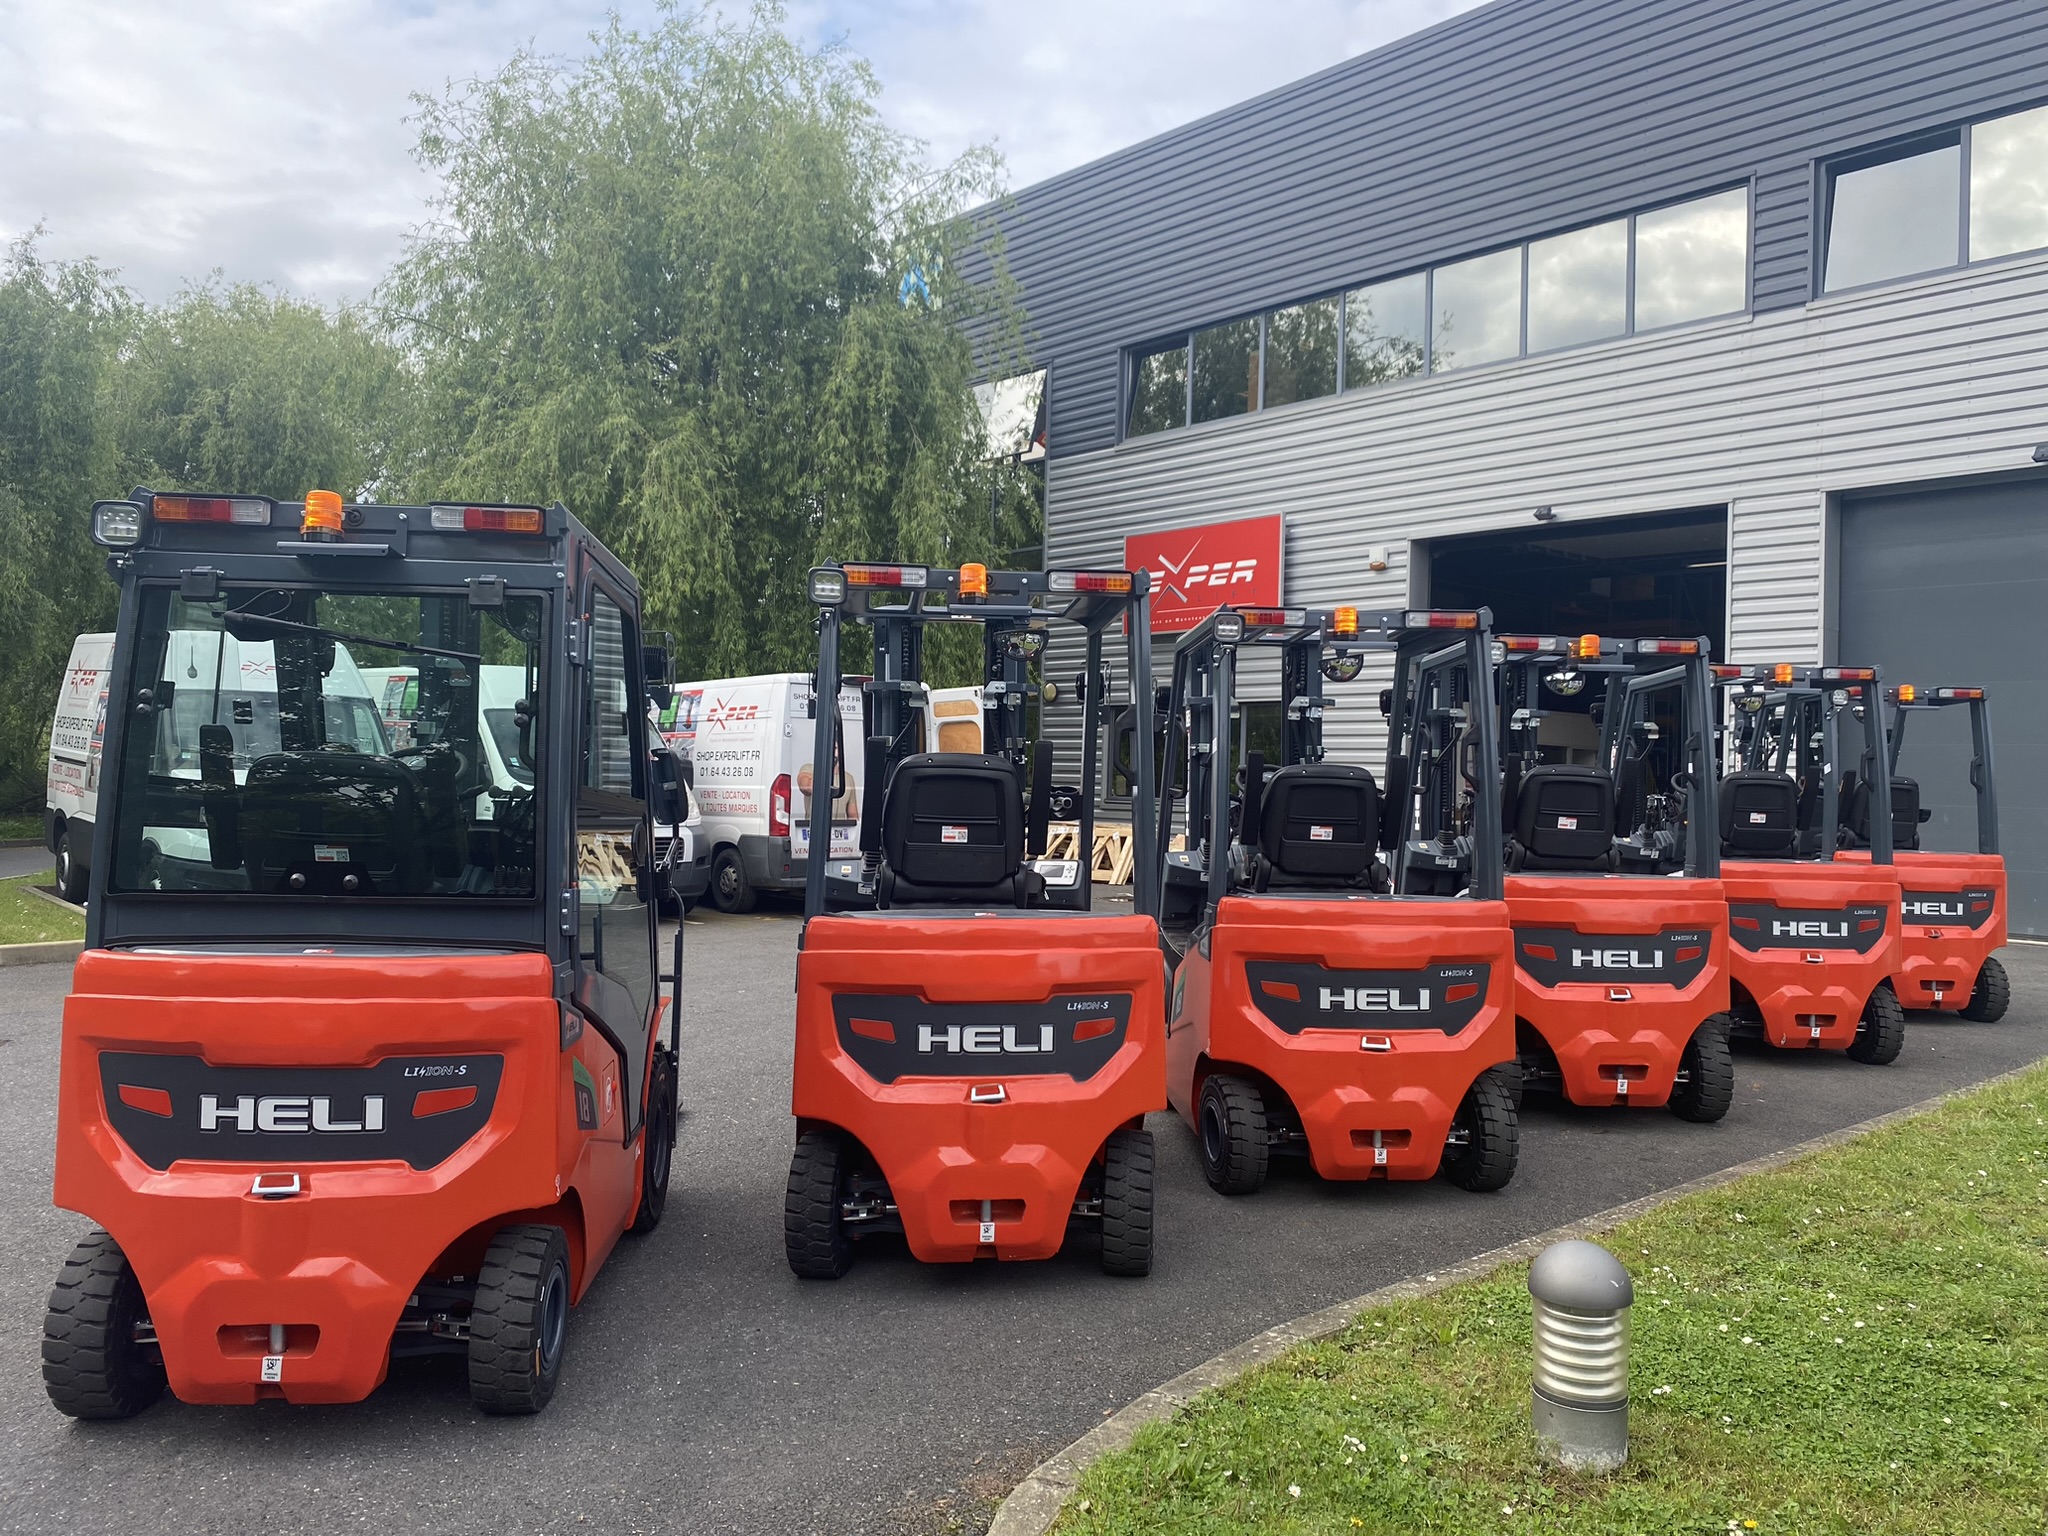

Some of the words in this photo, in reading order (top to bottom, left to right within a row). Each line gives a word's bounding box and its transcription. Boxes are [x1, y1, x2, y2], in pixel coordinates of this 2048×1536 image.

[1149, 540, 1257, 606] EXPER
[696, 750, 760, 762] SHOP.EXPERLIFT.FR
[699, 766, 754, 777] 01.64.43.26.08
[700, 790, 717, 799] VENTE
[722, 791, 751, 800] LOCATION
[705, 803, 727, 812] TOUTES
[728, 804, 757, 813] MARQUES
[1901, 902, 1963, 916] HELI
[1772, 920, 1848, 937] HELI
[1571, 948, 1663, 968] HELI
[1318, 987, 1430, 1011] HELI
[917, 1025, 1053, 1053] HELI
[199, 1096, 385, 1132] HELI
[578, 1091, 590, 1122] 18
